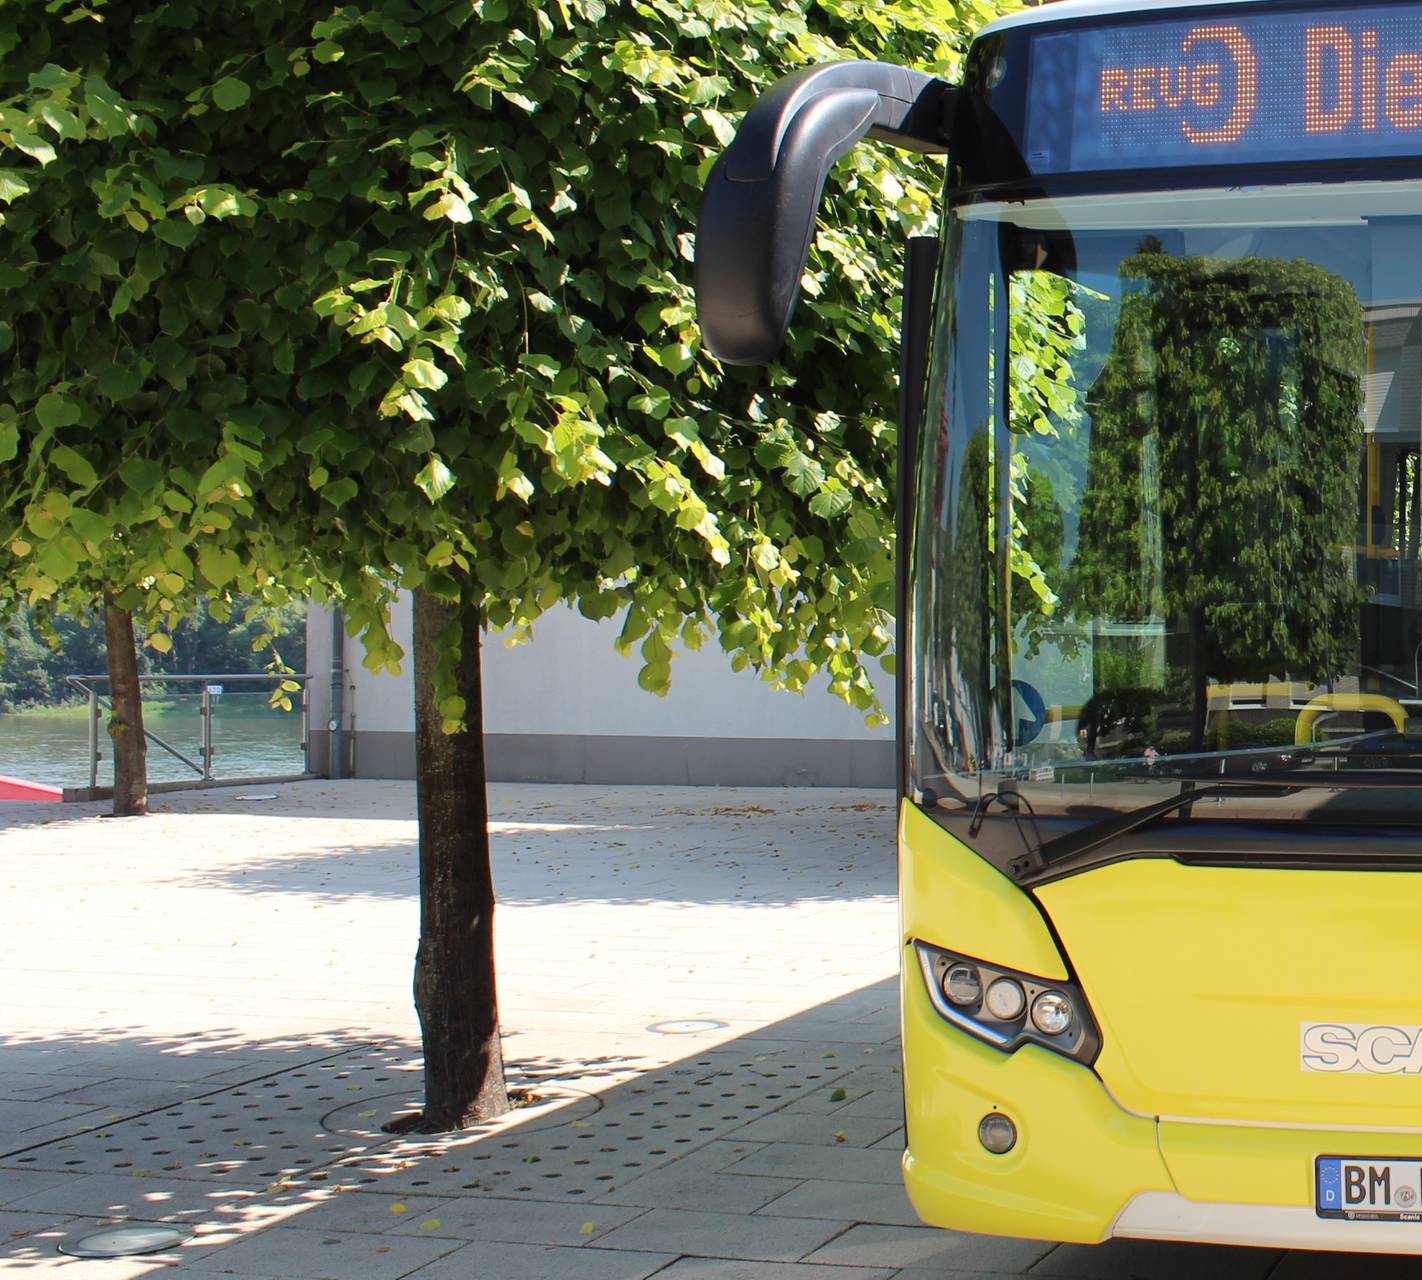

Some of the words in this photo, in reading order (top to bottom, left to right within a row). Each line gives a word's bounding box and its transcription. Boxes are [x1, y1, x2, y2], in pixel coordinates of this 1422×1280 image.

[1100, 63, 1221, 113] REVG
[1325, 1189, 1336, 1202] D
[1343, 1165, 1392, 1206] BM
[1399, 1212, 1420, 1221] Scania
